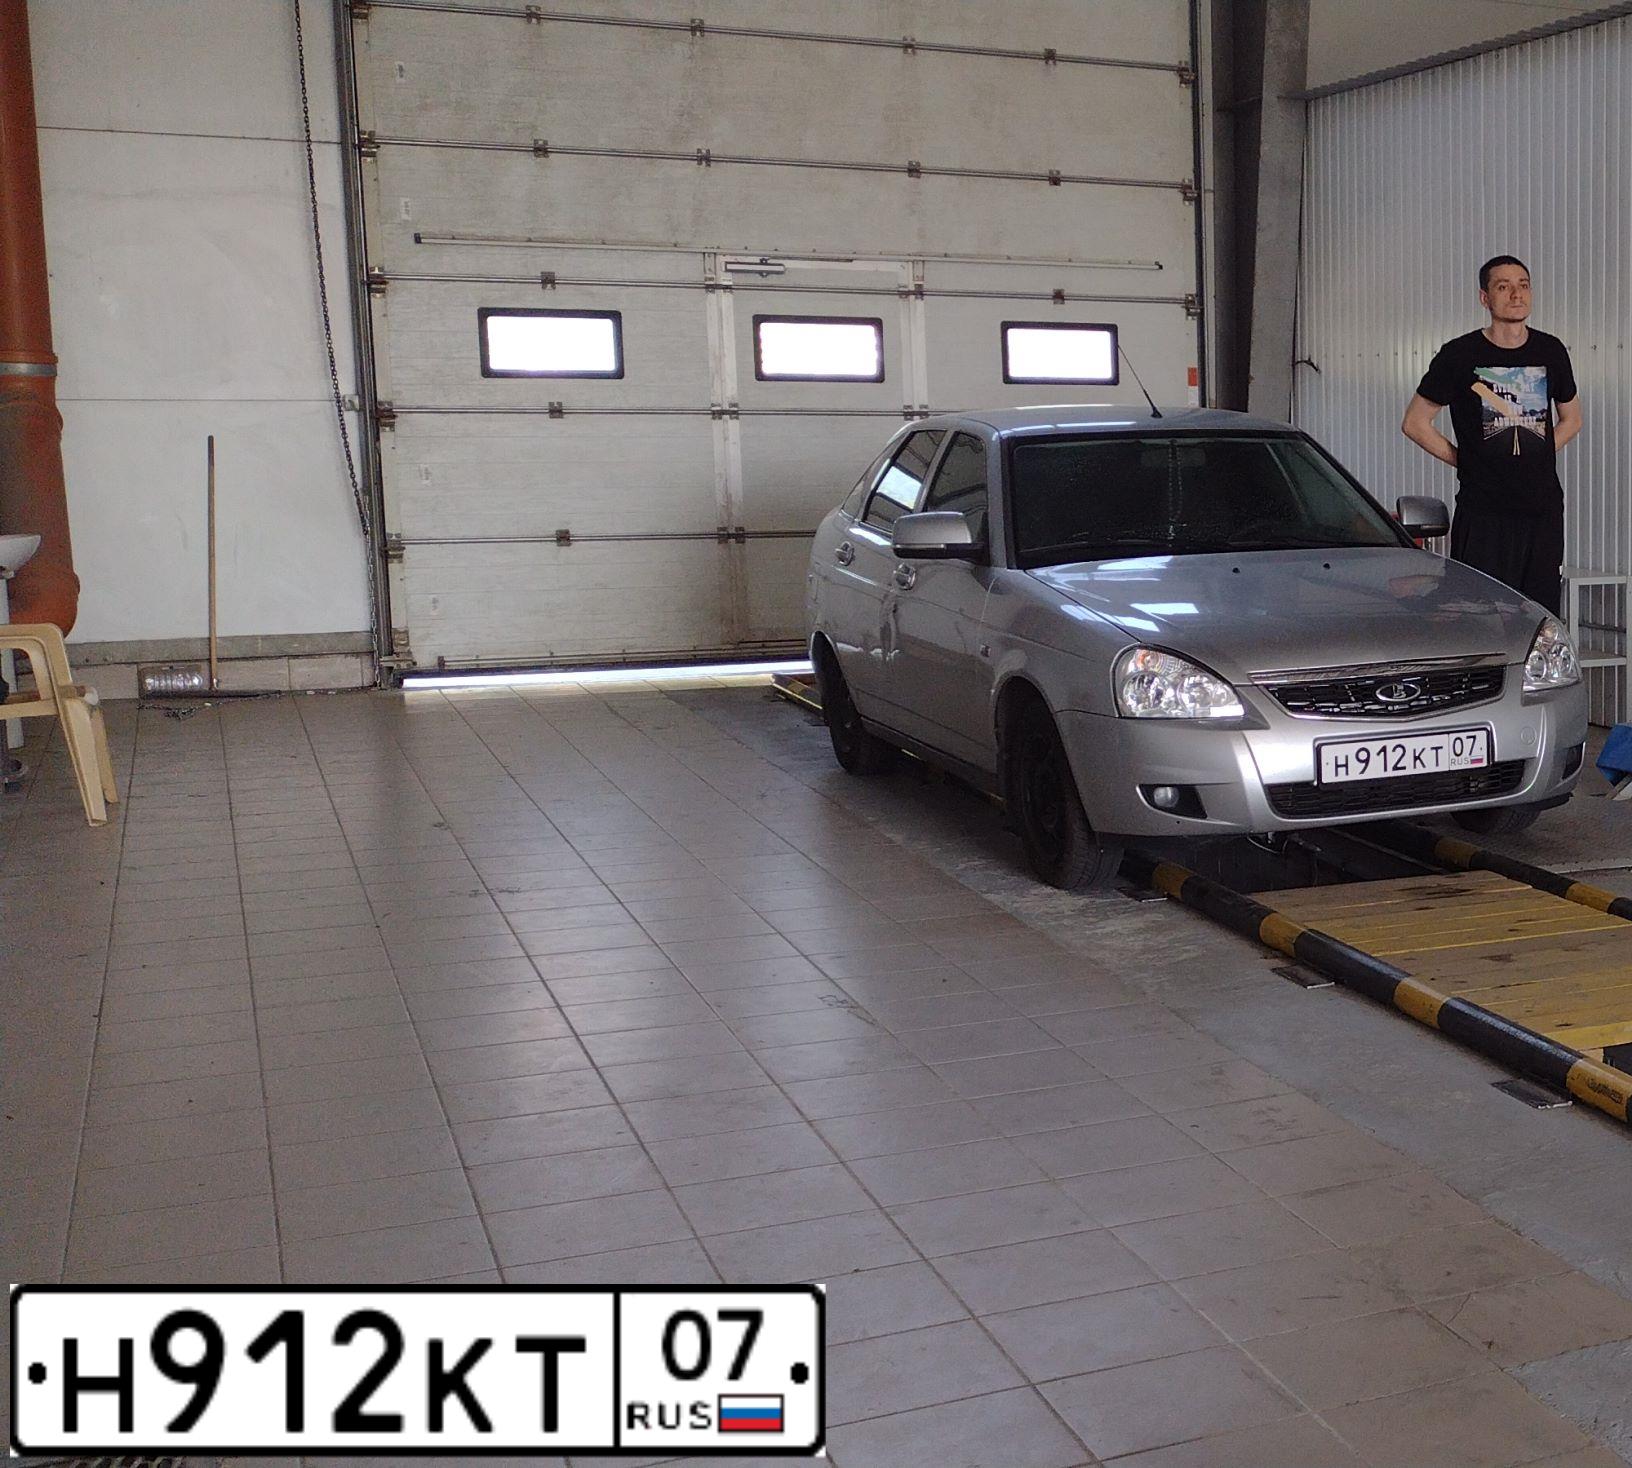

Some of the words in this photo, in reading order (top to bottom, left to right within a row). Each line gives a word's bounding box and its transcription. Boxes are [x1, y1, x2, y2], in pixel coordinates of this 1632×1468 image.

[1334, 743, 1443, 778] Н912КТ
[1452, 735, 1477, 757] 07
[1450, 757, 1470, 767] RUS
